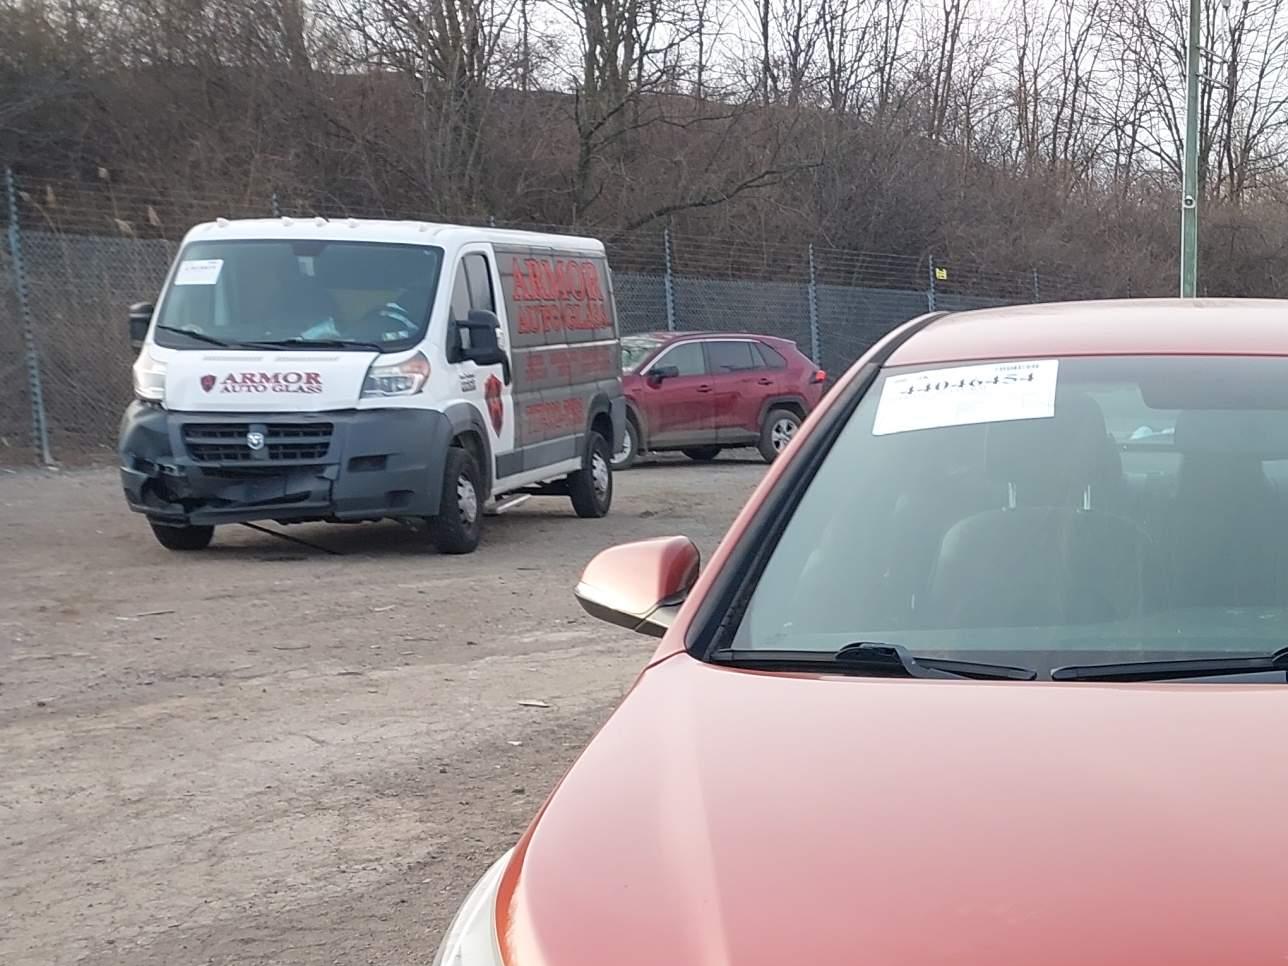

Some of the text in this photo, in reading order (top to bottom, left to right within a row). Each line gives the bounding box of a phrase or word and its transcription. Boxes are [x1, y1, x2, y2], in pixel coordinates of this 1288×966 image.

[512, 257, 604, 301] ARMOR
[219, 371, 323, 386] ARMOR
[219, 384, 323, 395] AUTO GLASS
